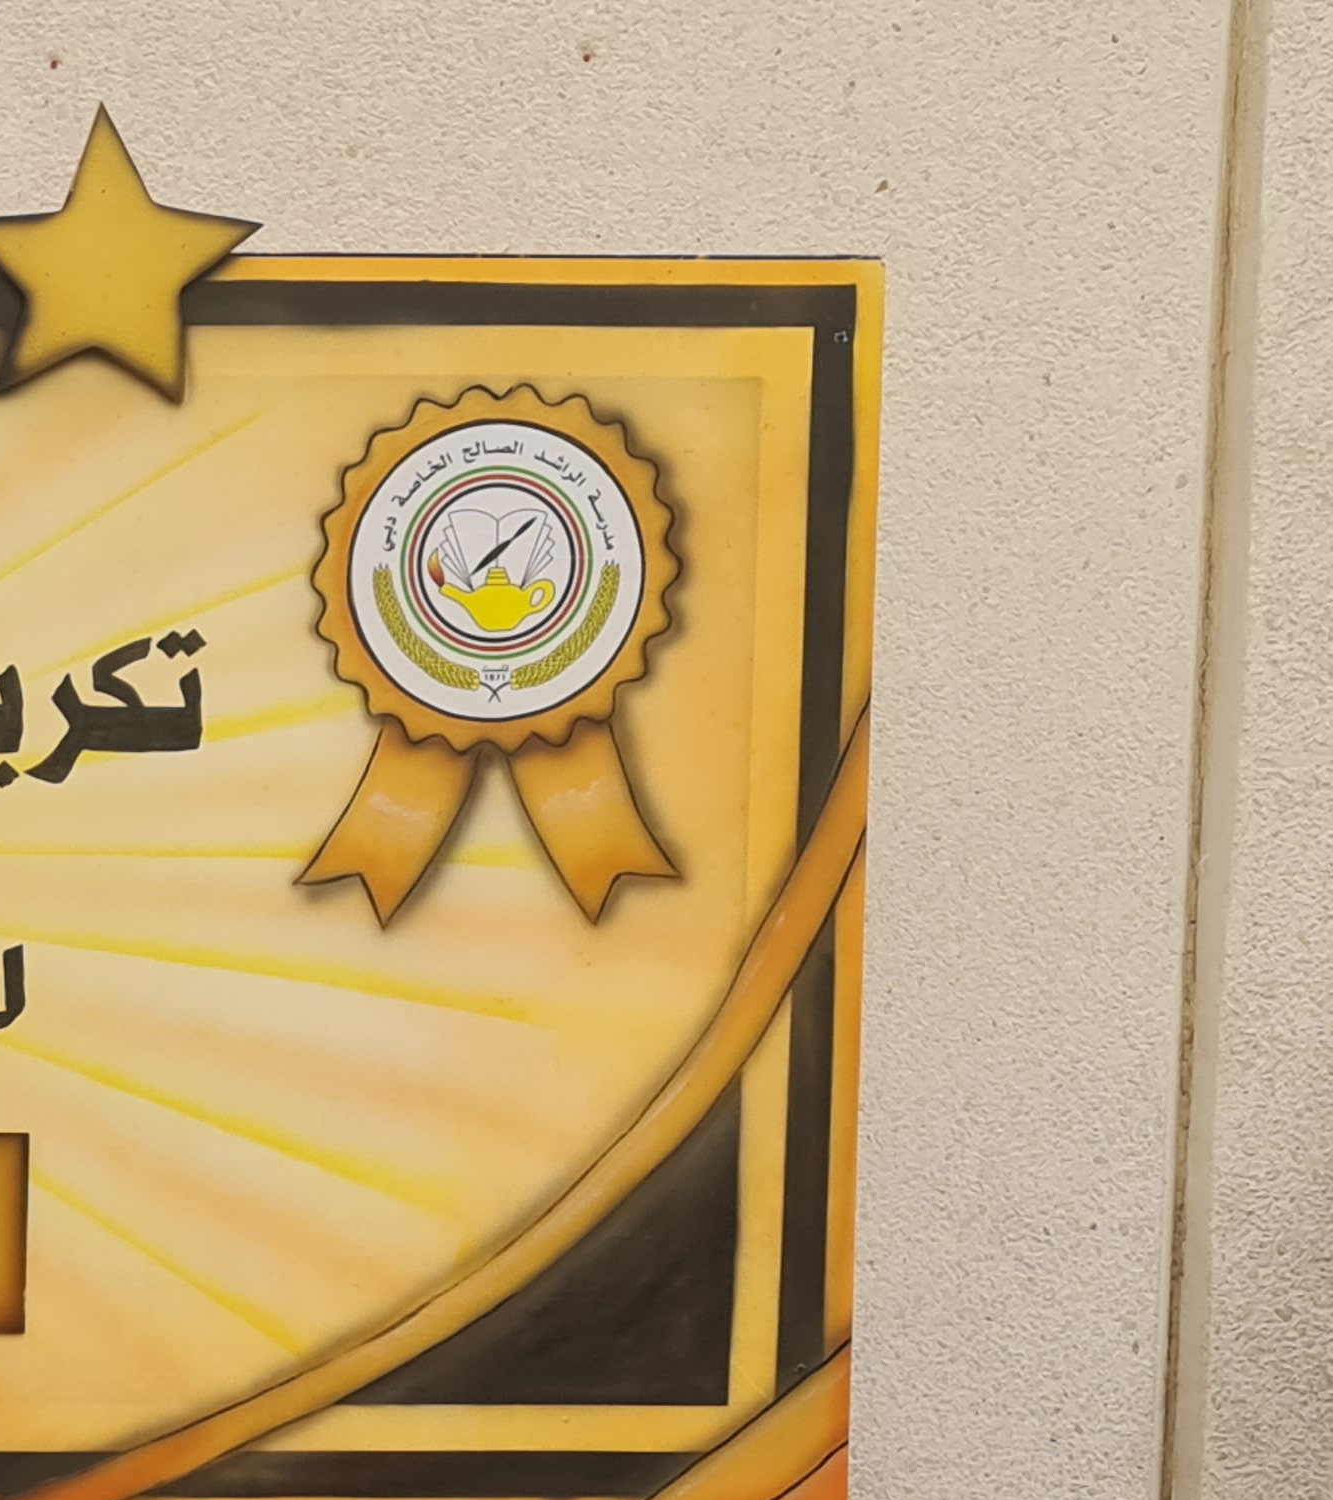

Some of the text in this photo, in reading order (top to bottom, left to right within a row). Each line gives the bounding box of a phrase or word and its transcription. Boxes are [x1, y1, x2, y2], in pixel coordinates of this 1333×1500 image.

[461, 440, 524, 464] الصالح
[534, 449, 587, 488] الراشد
[390, 452, 454, 508] الخاصة
[587, 488, 615, 551] مدرسة
